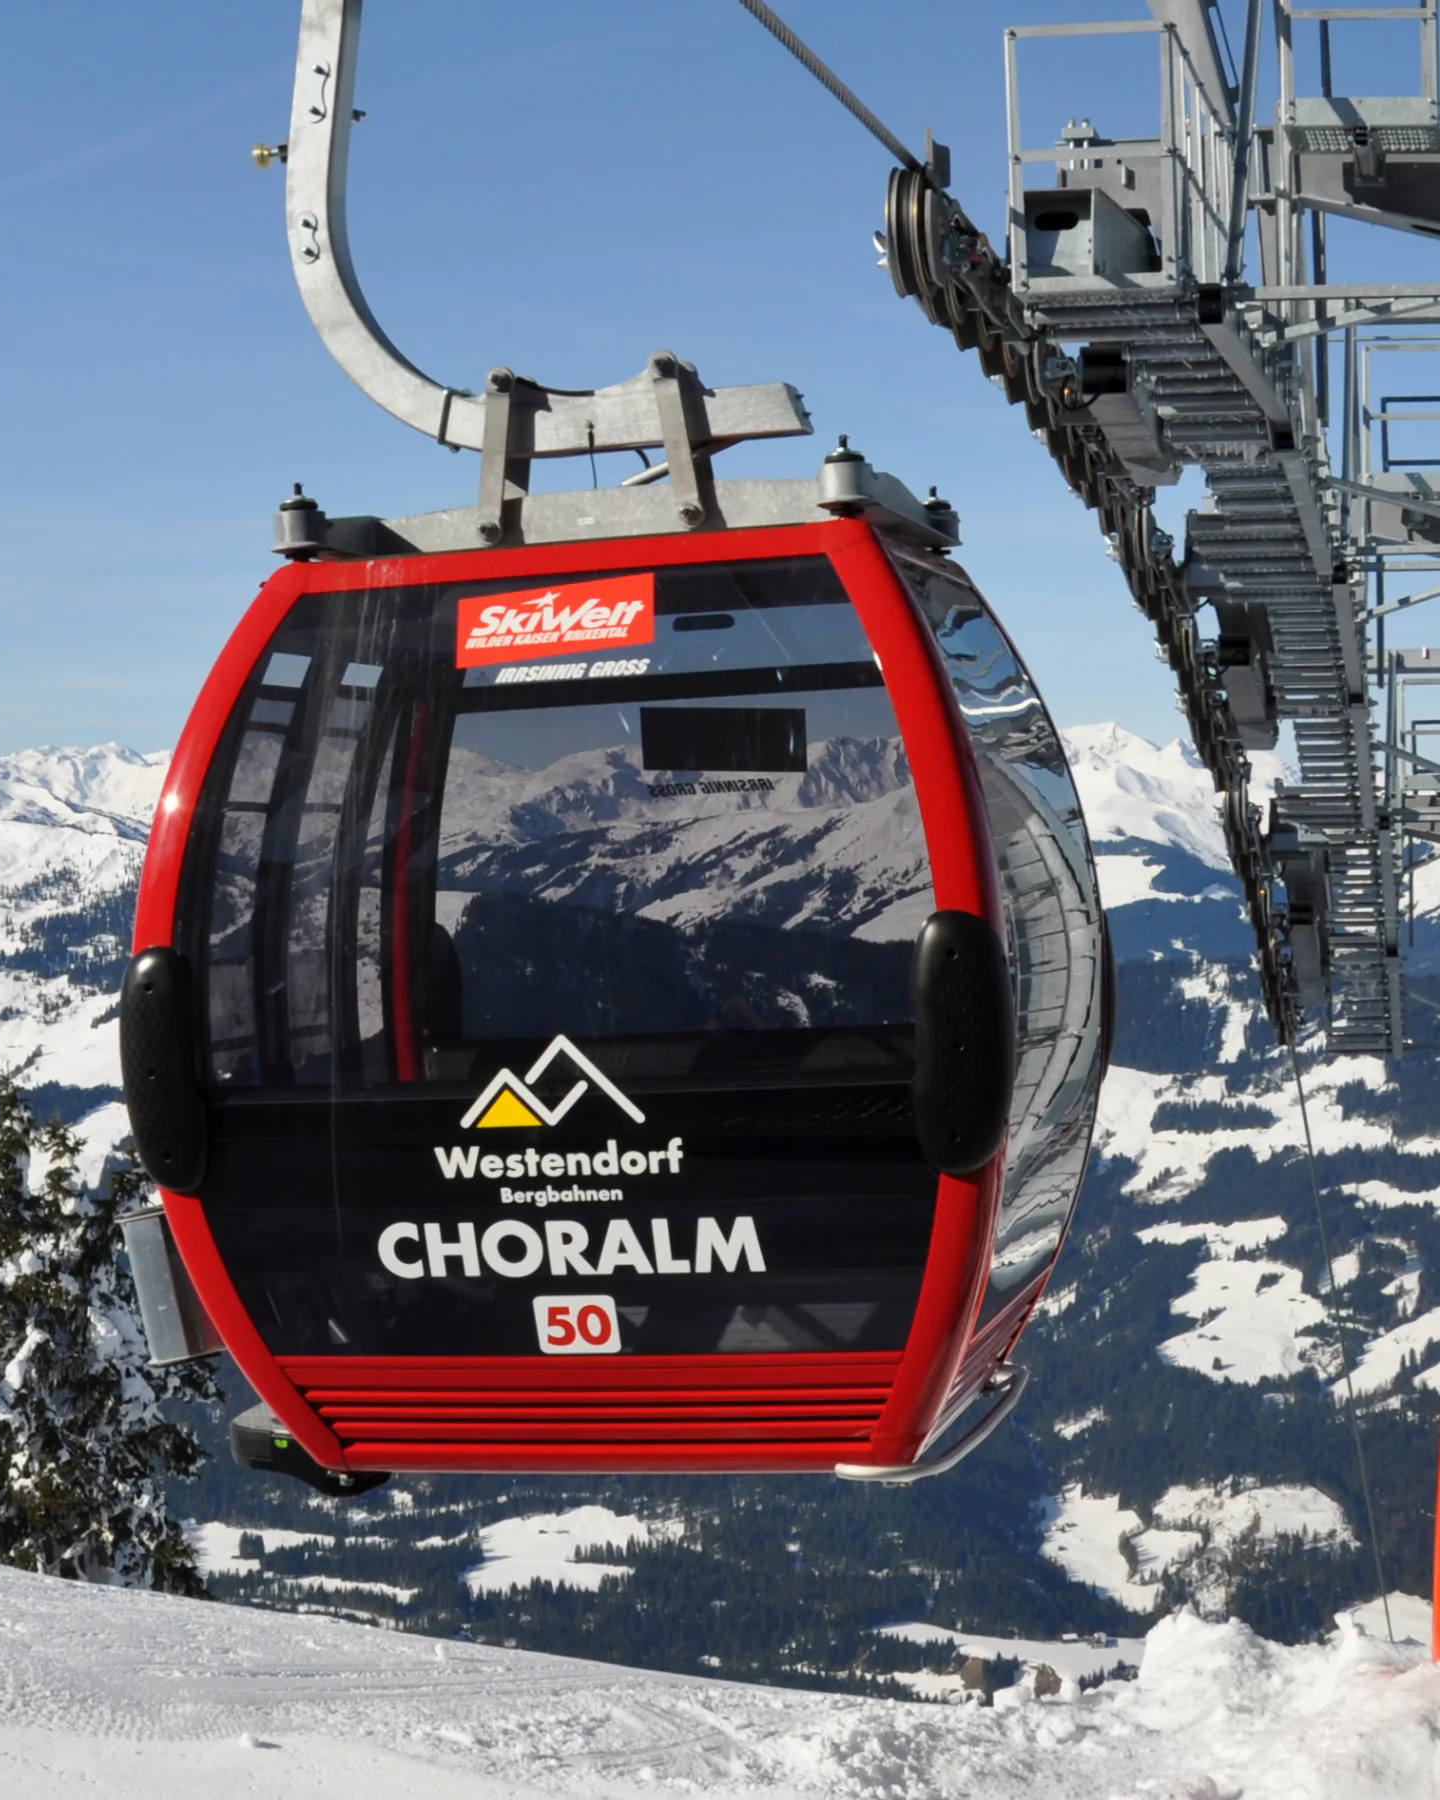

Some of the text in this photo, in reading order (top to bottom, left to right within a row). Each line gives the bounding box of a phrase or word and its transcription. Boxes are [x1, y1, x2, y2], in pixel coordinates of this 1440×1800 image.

[470, 597, 645, 637] SkiWelt
[465, 626, 629, 650] WILDER KAISER BRIXENTAL
[494, 658, 651, 684] IRRSINNIG GROSS
[434, 1137, 684, 1179] Westendorf
[500, 1184, 624, 1208] Bergbahnen
[377, 1216, 767, 1279] CHORALM
[546, 1303, 612, 1347] 50
